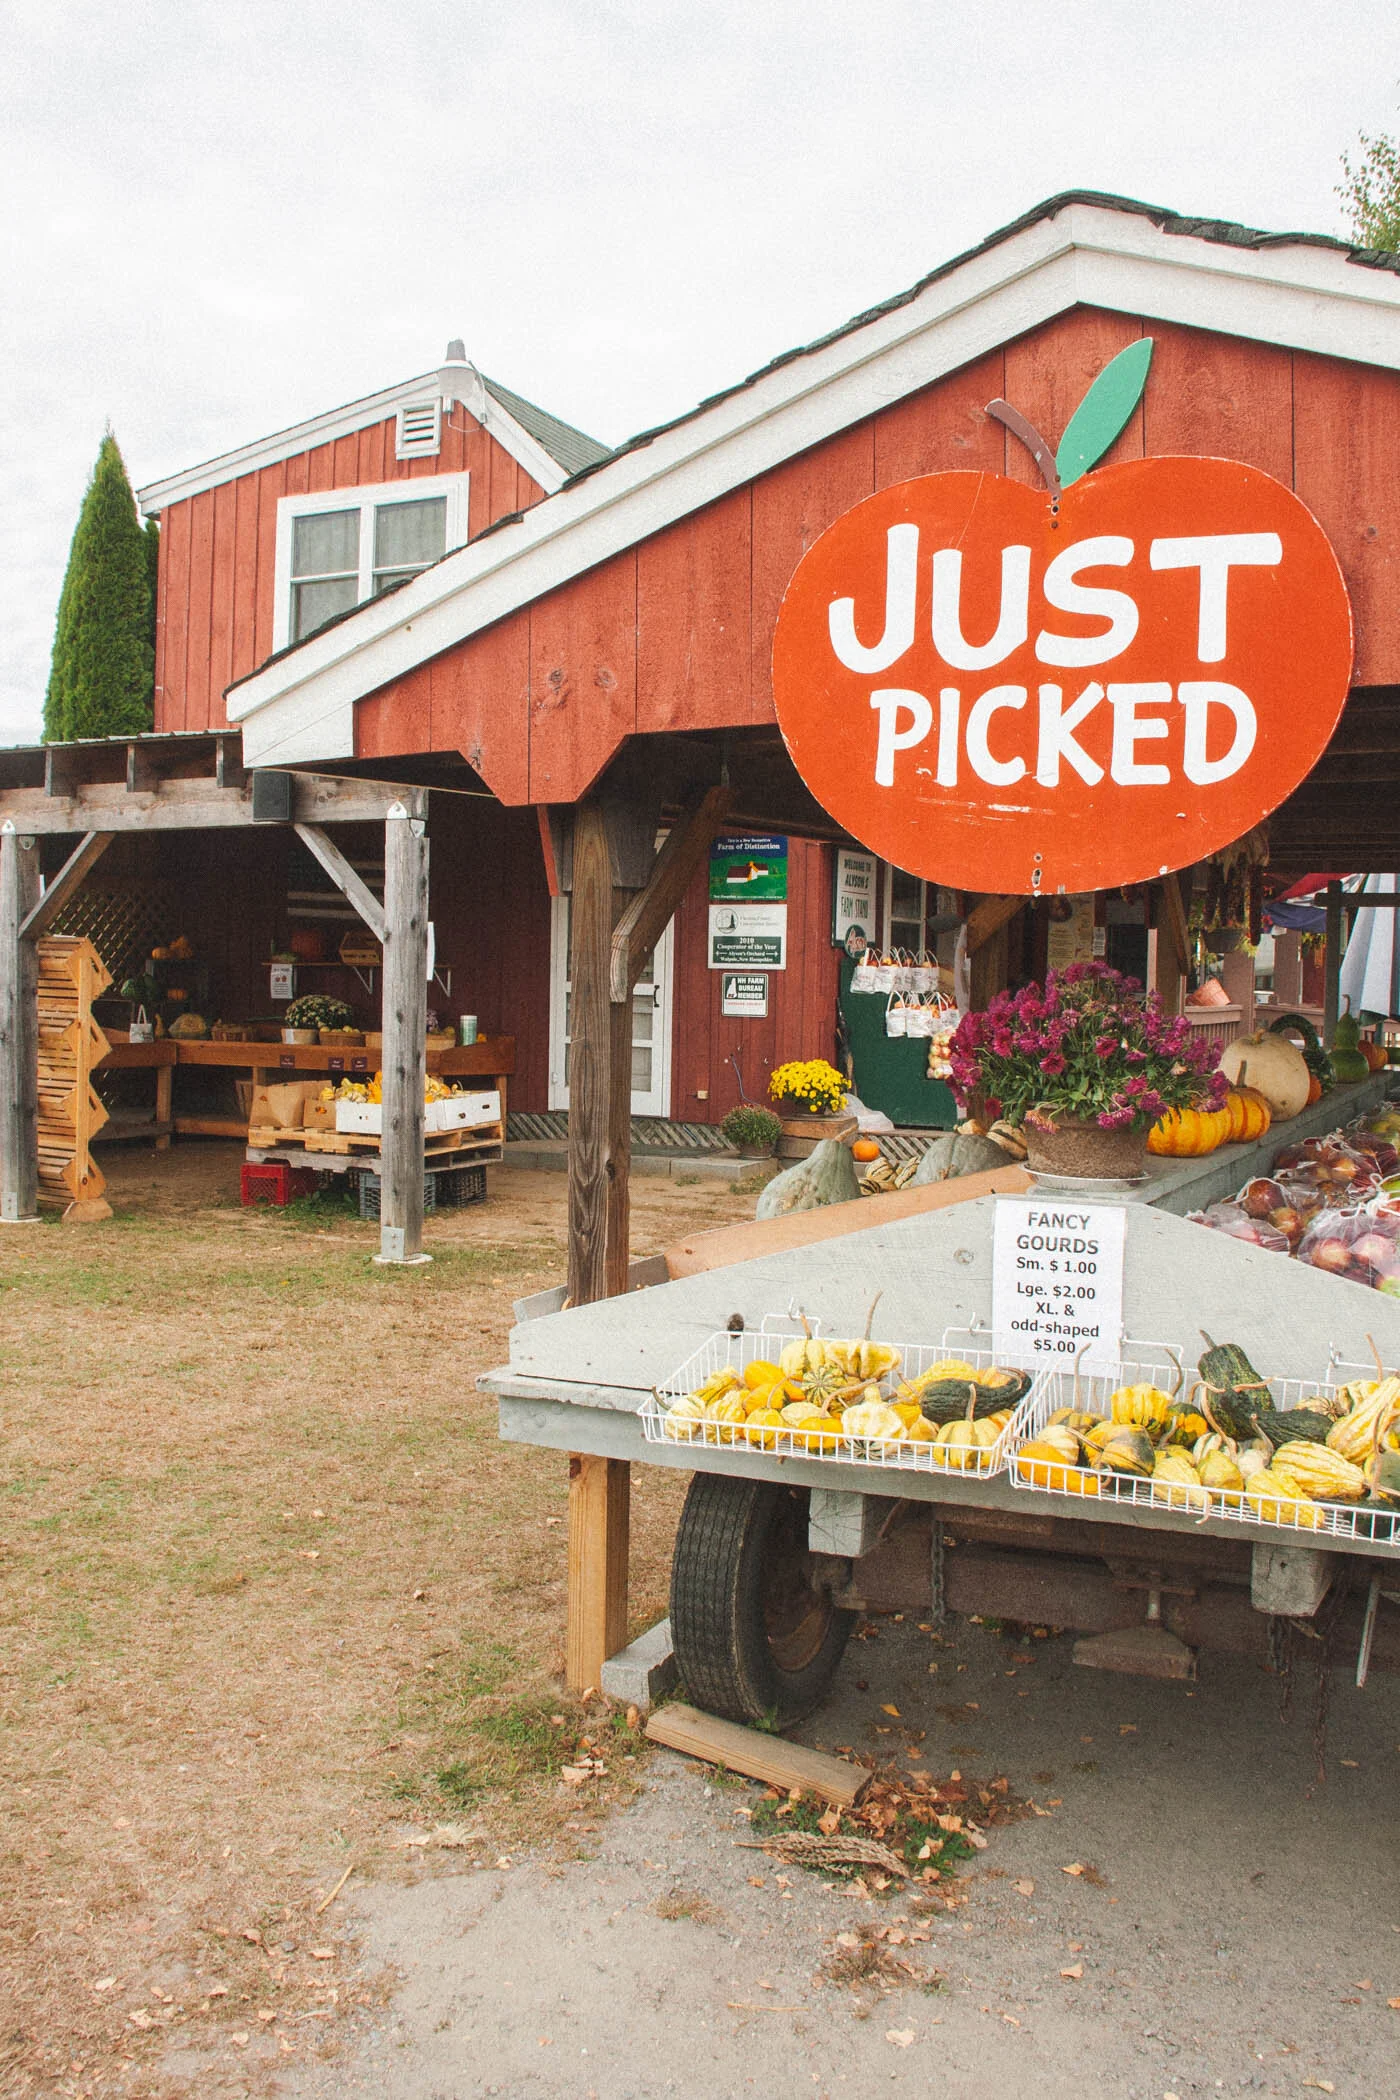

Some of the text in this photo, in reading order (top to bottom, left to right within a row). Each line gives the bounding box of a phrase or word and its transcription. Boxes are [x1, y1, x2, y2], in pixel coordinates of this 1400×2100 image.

[828, 523, 1283, 674] JUST
[870, 681, 1257, 788] PICKED
[744, 842, 780, 850] Distinction
[1028, 1211, 1091, 1230] FANCY
[1016, 1234, 1099, 1255] GOURDS
[1016, 1257, 1097, 1275] Sm. $ 1.00
[1017, 1282, 1096, 1300] Lge. $2.00
[1036, 1302, 1075, 1317] XL. &
[1011, 1319, 1099, 1338] odd-shaped
[1034, 1339, 1076, 1354] $5.00
